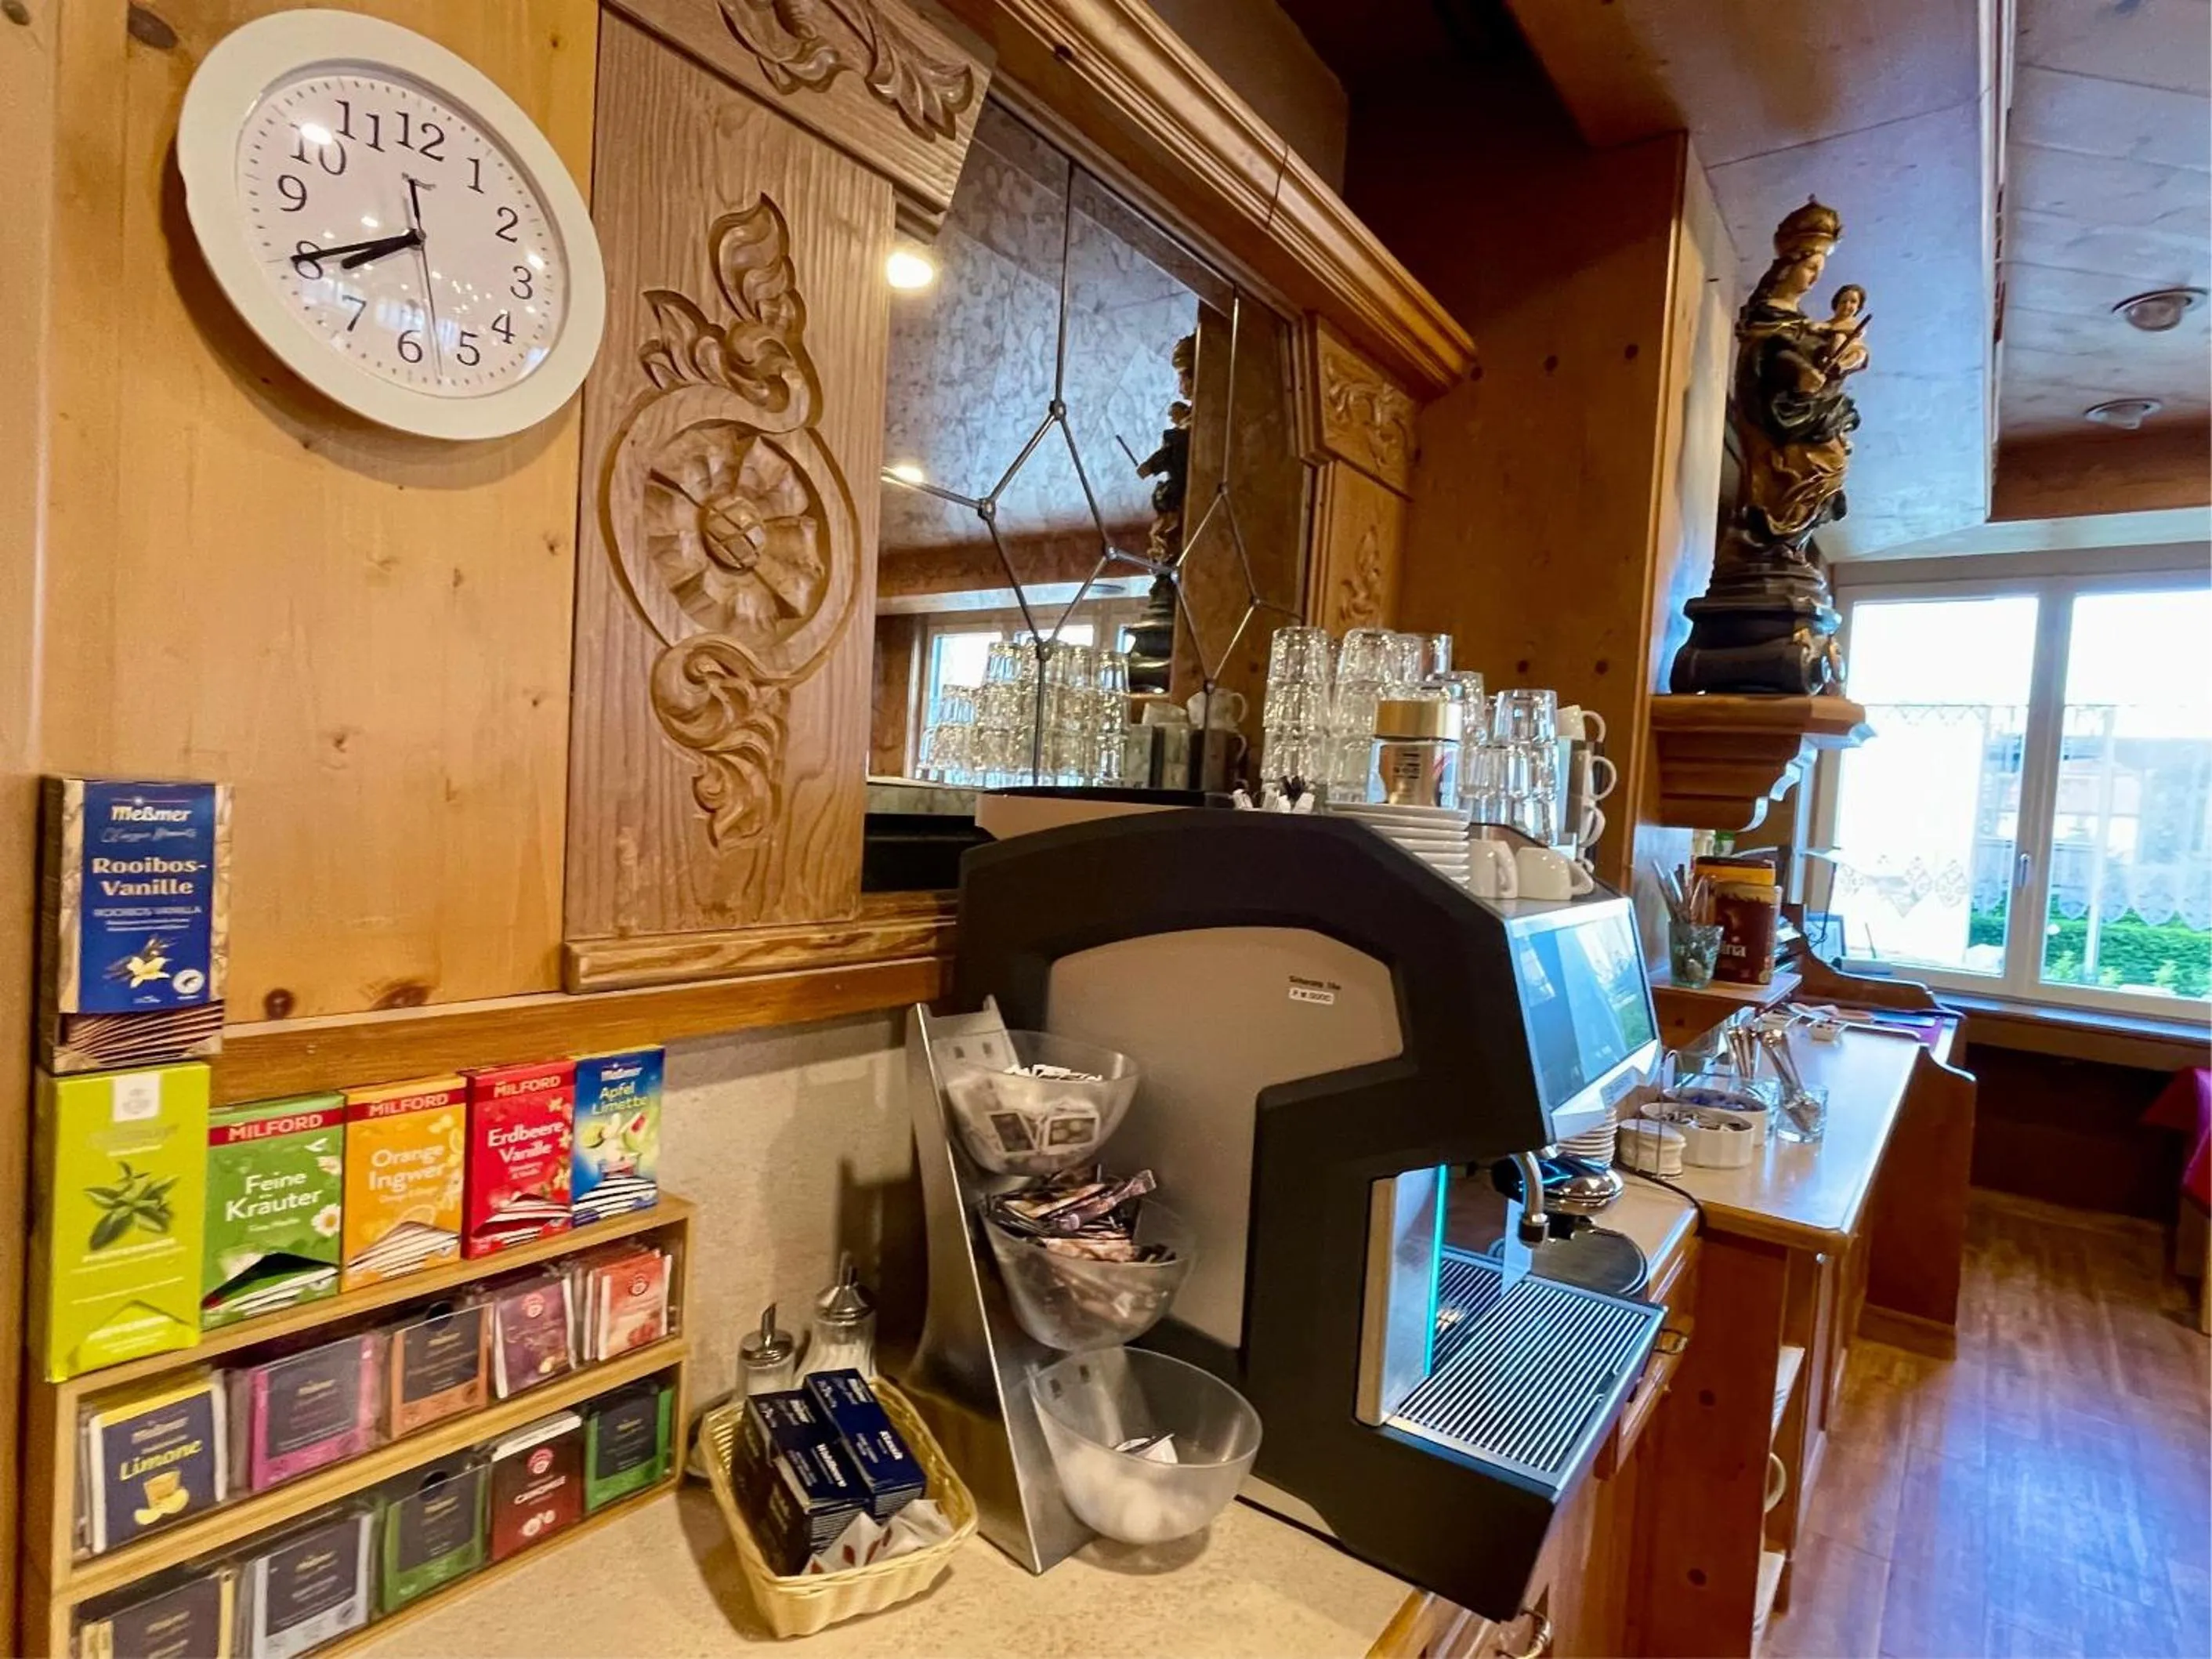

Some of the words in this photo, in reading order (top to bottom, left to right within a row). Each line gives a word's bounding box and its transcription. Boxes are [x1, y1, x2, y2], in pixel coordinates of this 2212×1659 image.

[335, 100, 386, 152] 11
[395, 111, 445, 161] 12
[289, 123, 346, 176] 10
[277, 174, 308, 212] 9
[467, 158, 485, 194] 1
[495, 206, 519, 243] 2
[295, 241, 324, 280] 8
[509, 266, 534, 300] 3
[342, 295, 367, 332] 7
[491, 311, 516, 345] 4
[398, 329, 423, 364] 6
[456, 331, 480, 367] 5
[92, 856, 208, 874] Rooibos-
[100, 878, 194, 896] Vanille
[494, 1075, 561, 1097] MILFORD
[599, 1081, 635, 1102] Apfel
[369, 1093, 449, 1117] MILFORD
[228, 1114, 324, 1142] MILFORD
[487, 1121, 564, 1147] Erdbeere
[371, 1144, 445, 1168] Orange
[498, 1140, 552, 1163] Vanille
[244, 1172, 308, 1194] Feine
[368, 1163, 447, 1193] Ingwer
[225, 1190, 324, 1222] Kräuter
[120, 1440, 203, 1481] Limone
